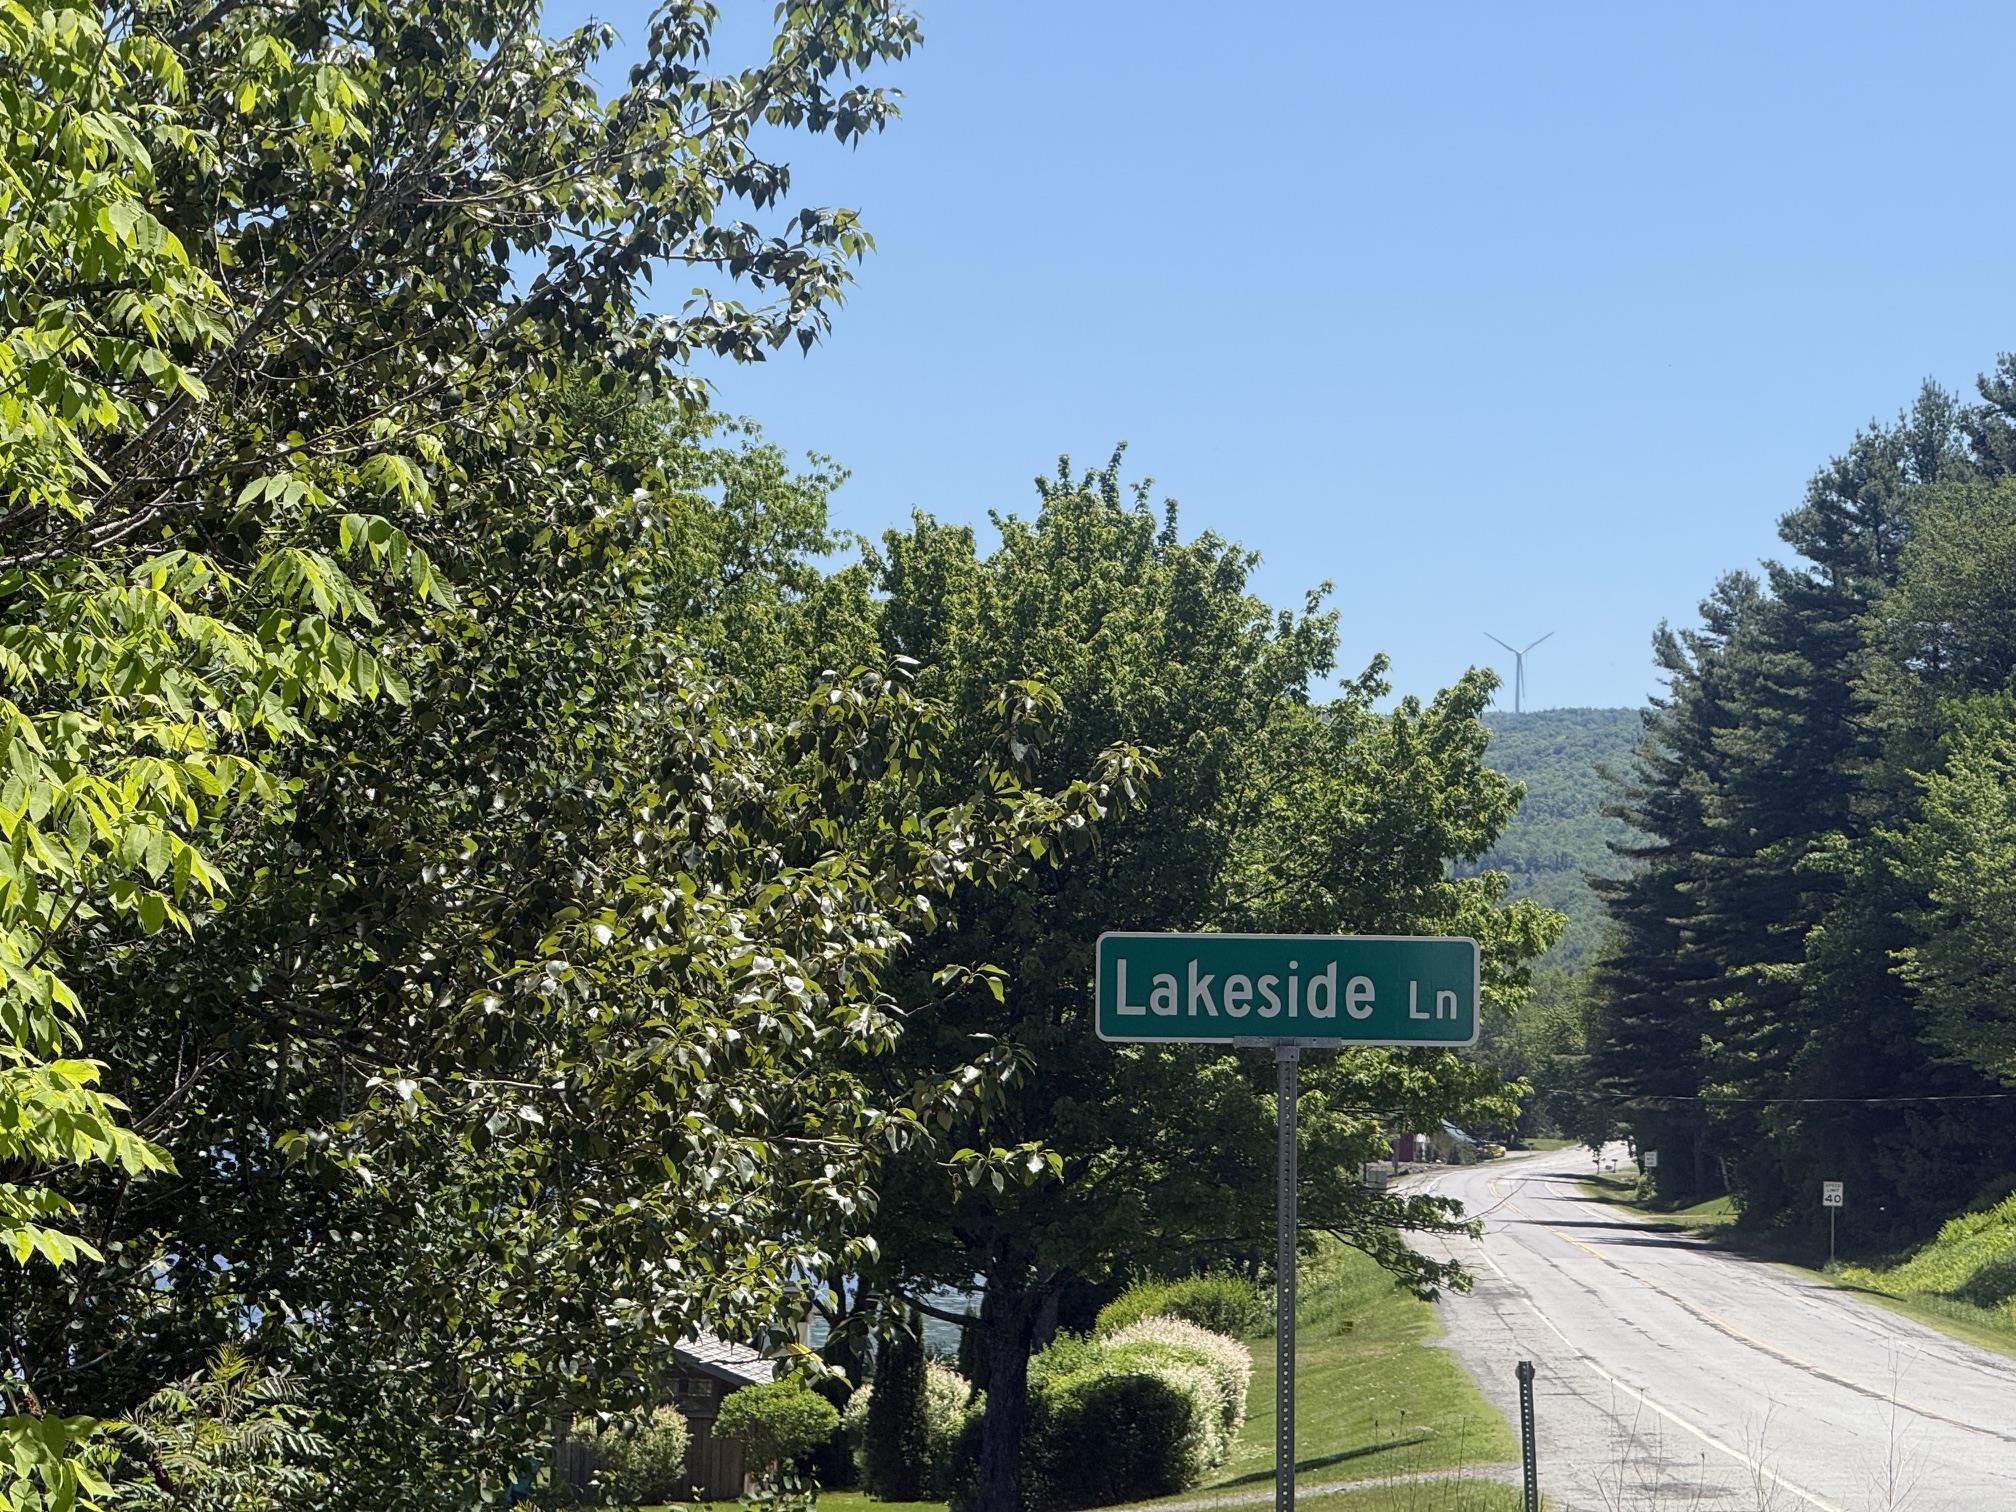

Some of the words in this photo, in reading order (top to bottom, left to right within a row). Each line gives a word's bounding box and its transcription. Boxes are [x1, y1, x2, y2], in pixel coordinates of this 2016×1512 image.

[1116, 958, 1376, 1019] Lakeside
[1409, 980, 1458, 1020] Ln
[1825, 1194, 1841, 1203] 40
